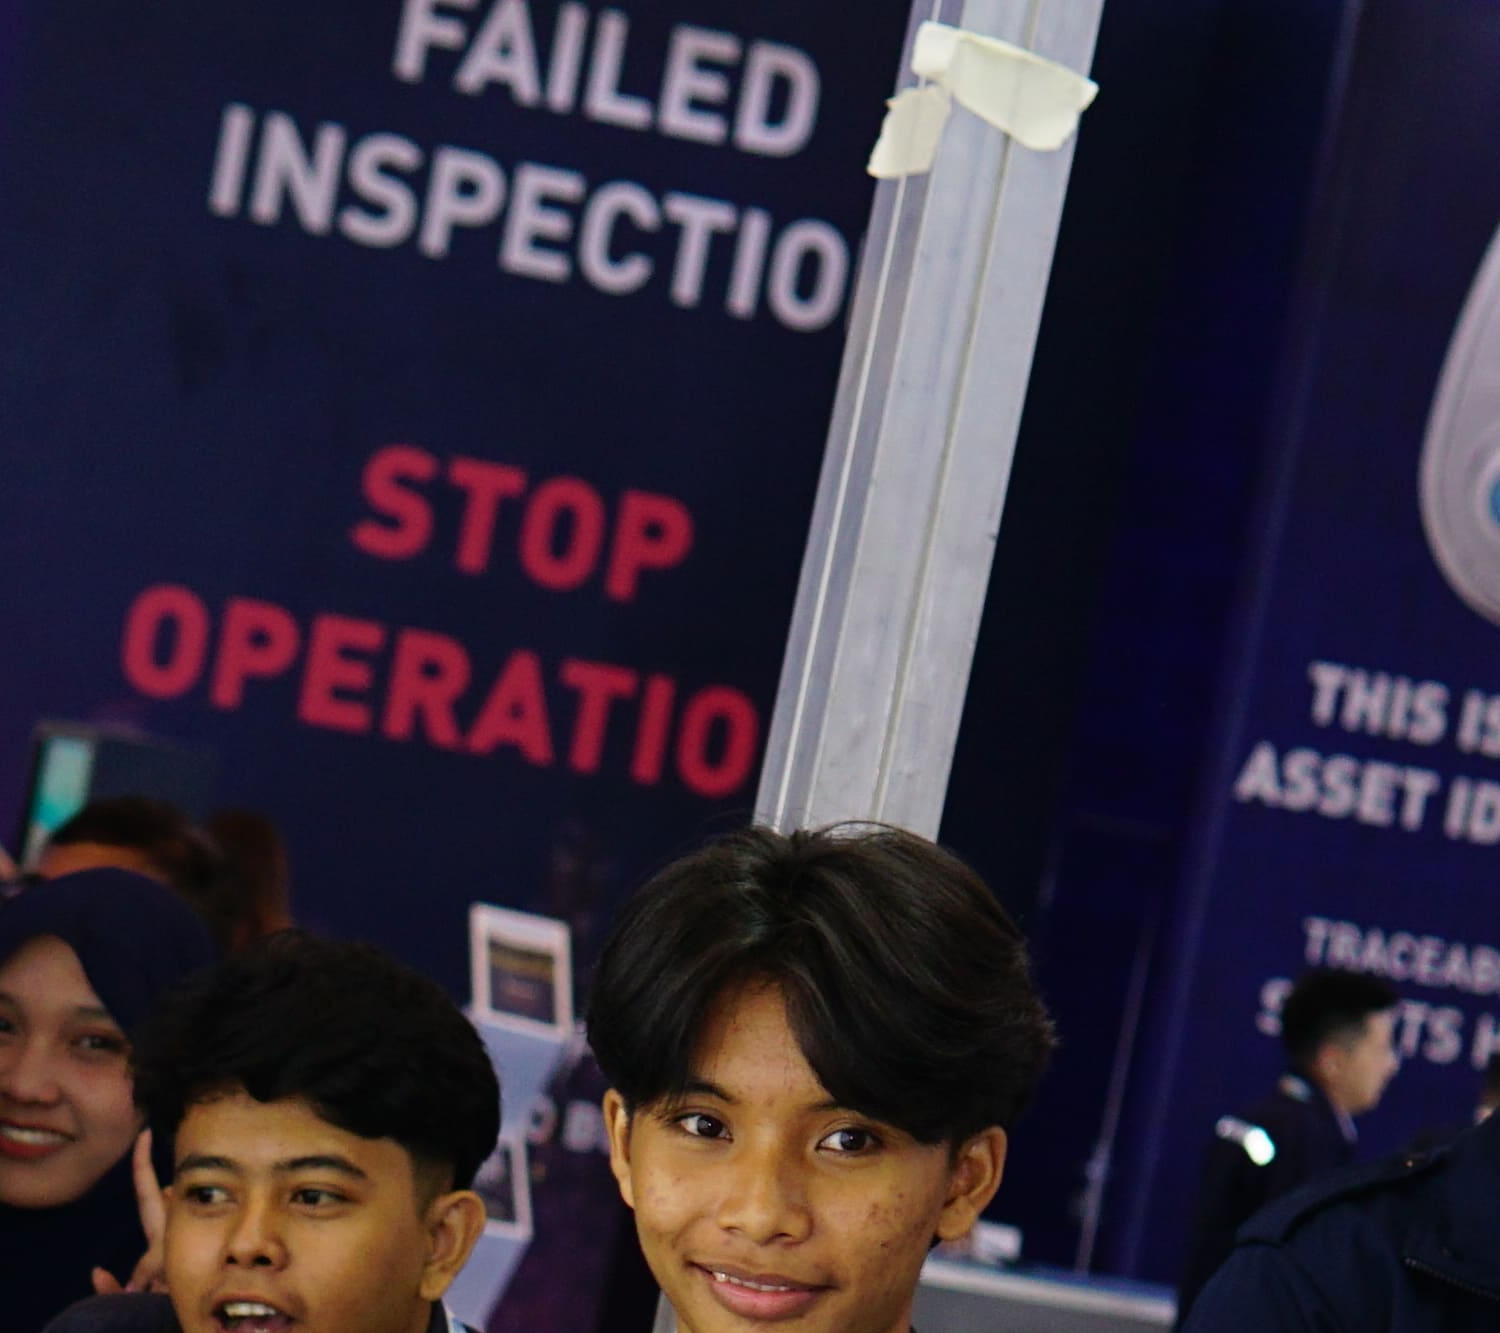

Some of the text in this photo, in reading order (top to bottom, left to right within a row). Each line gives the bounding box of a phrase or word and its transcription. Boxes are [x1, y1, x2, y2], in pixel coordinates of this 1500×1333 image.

[395, 0, 819, 157] FAILED
[209, 103, 852, 333] INSPECTIO
[352, 443, 694, 600] STOP
[122, 583, 760, 797] OPERATIO
[1308, 660, 1450, 747] THIS
[1233, 740, 1440, 831] ASSET
